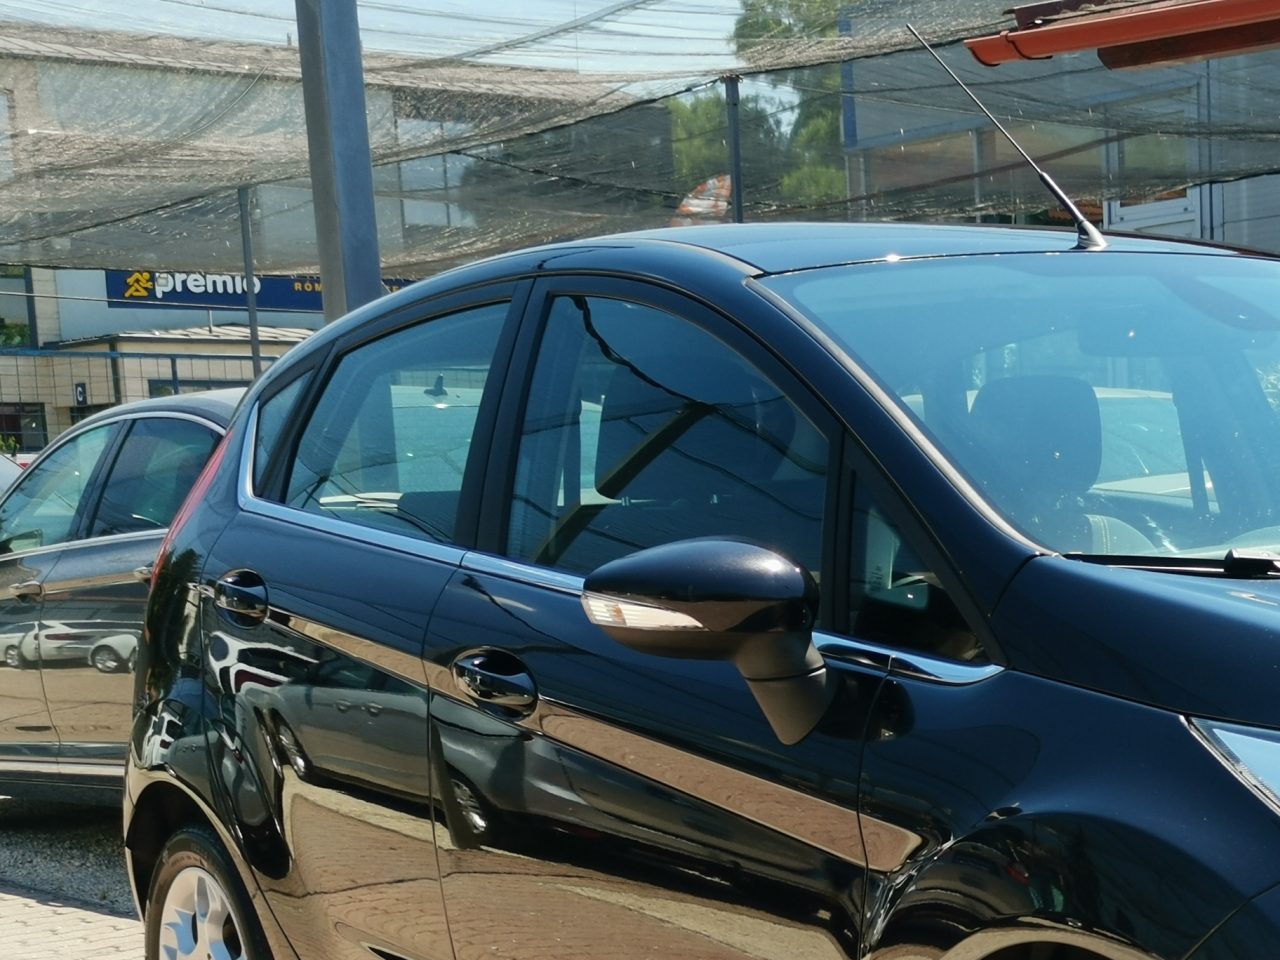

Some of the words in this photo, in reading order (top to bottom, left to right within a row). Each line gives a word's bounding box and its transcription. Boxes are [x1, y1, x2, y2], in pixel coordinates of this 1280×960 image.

[155, 272, 261, 299] premio
[294, 281, 322, 292] RÓM
[77, 386, 84, 402] C
